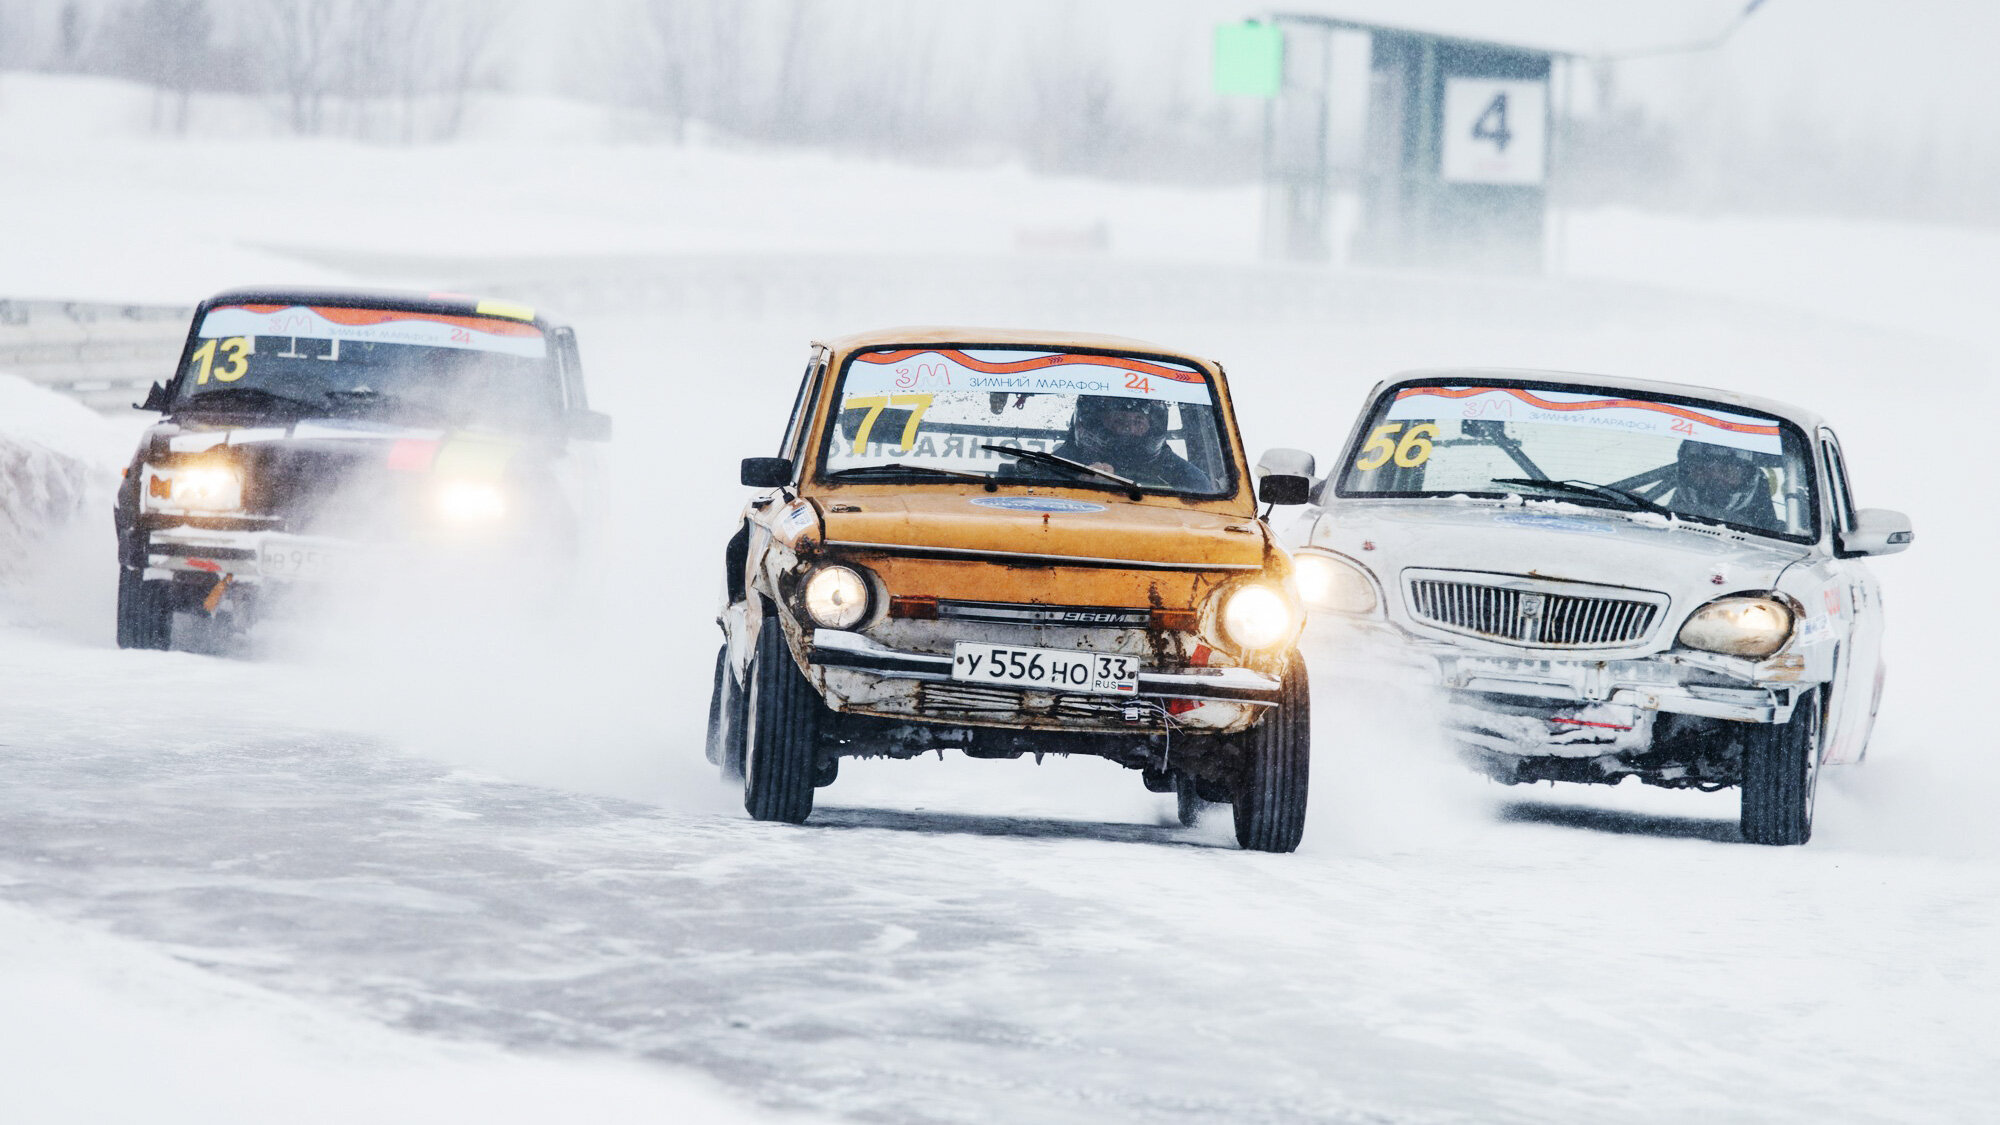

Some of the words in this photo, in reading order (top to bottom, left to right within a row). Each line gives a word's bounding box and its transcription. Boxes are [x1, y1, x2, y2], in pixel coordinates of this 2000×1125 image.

[1471, 92, 1512, 152] 4
[192, 336, 249, 385] 13
[969, 374, 1031, 389] ЗИМНИЙ
[1036, 378, 1110, 392] МАРАФОН
[845, 393, 934, 455] 77
[1528, 410, 1585, 423] ЗИМНИЙ
[1589, 416, 1657, 432] МАРАФОН
[1356, 423, 1440, 471] 56
[989, 649, 1045, 681] 556
[1097, 657, 1127, 681] 33
[1095, 679, 1117, 690] RUS
